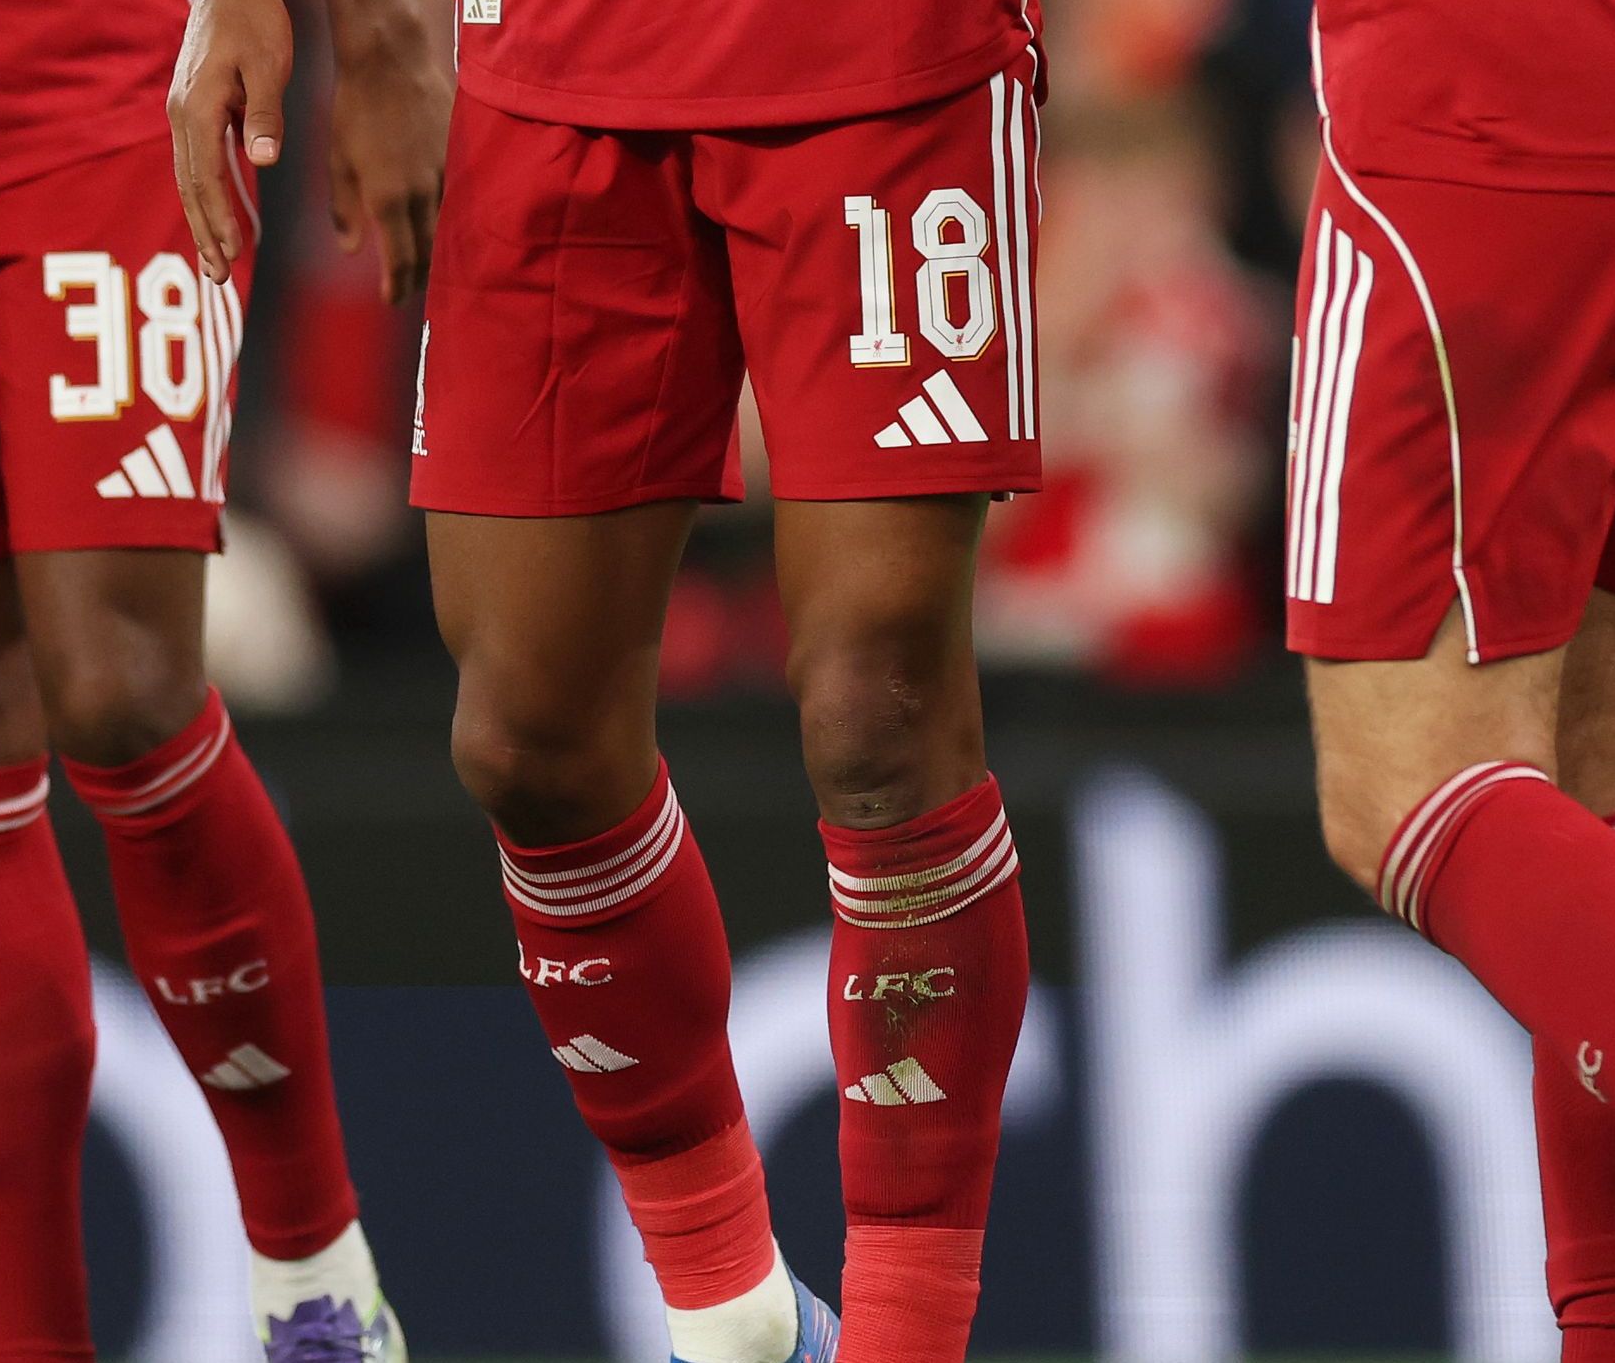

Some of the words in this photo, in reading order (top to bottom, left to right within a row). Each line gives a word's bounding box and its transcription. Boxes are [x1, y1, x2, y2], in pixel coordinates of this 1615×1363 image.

[844, 188, 998, 368] 18
[43, 251, 207, 423] 38
[155, 960, 270, 1006] LFC
[518, 940, 613, 987] LFC
[843, 966, 955, 1004] LFC
